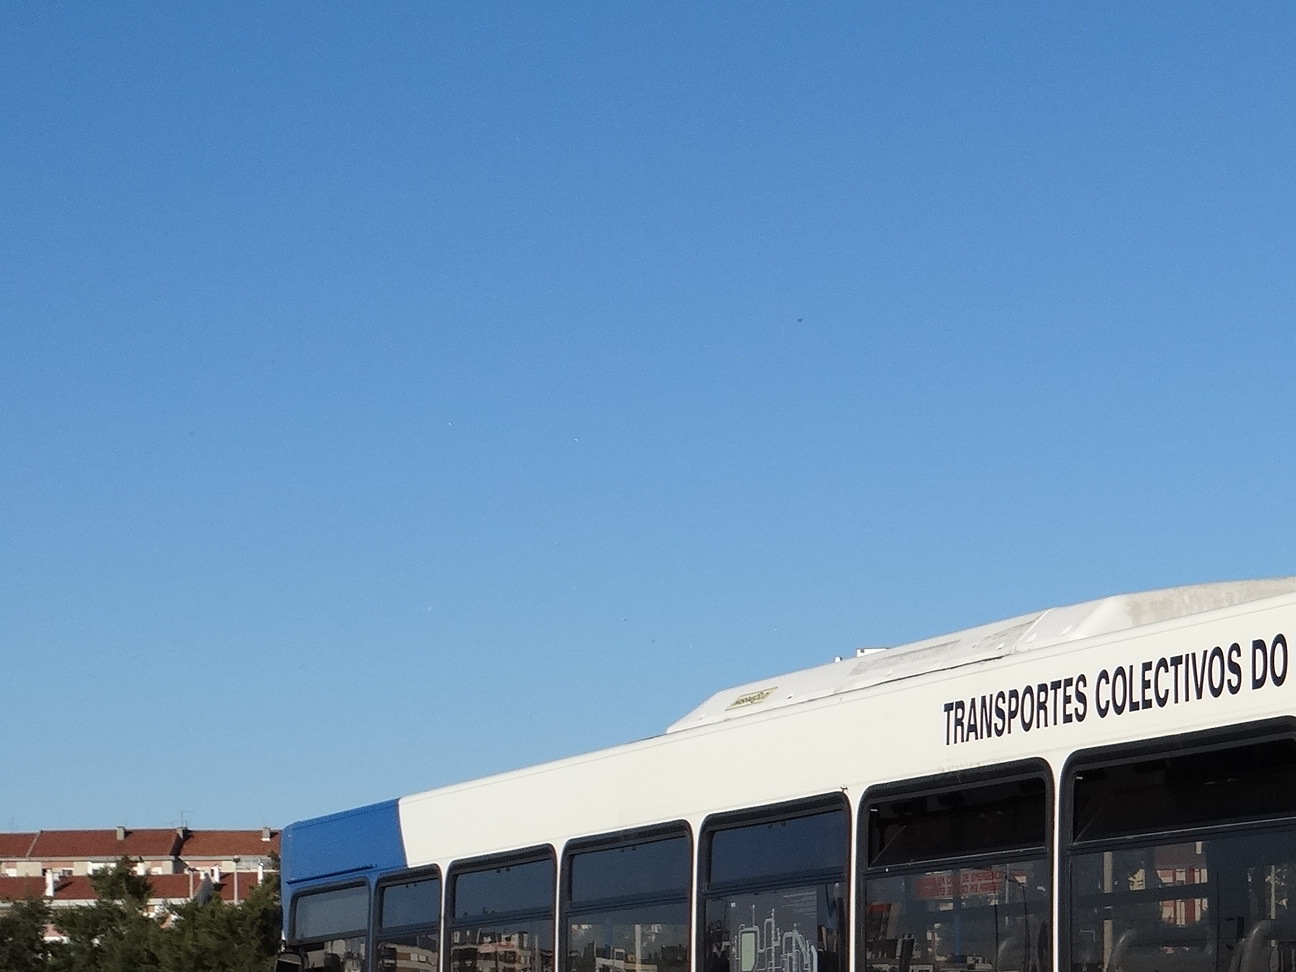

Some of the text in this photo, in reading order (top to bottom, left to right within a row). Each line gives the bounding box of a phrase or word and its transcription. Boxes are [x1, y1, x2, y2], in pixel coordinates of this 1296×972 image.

[943, 674, 1087, 746] TRANSPORTES
[1095, 643, 1242, 717] COLECTIVOS
[1251, 634, 1288, 691] DO
